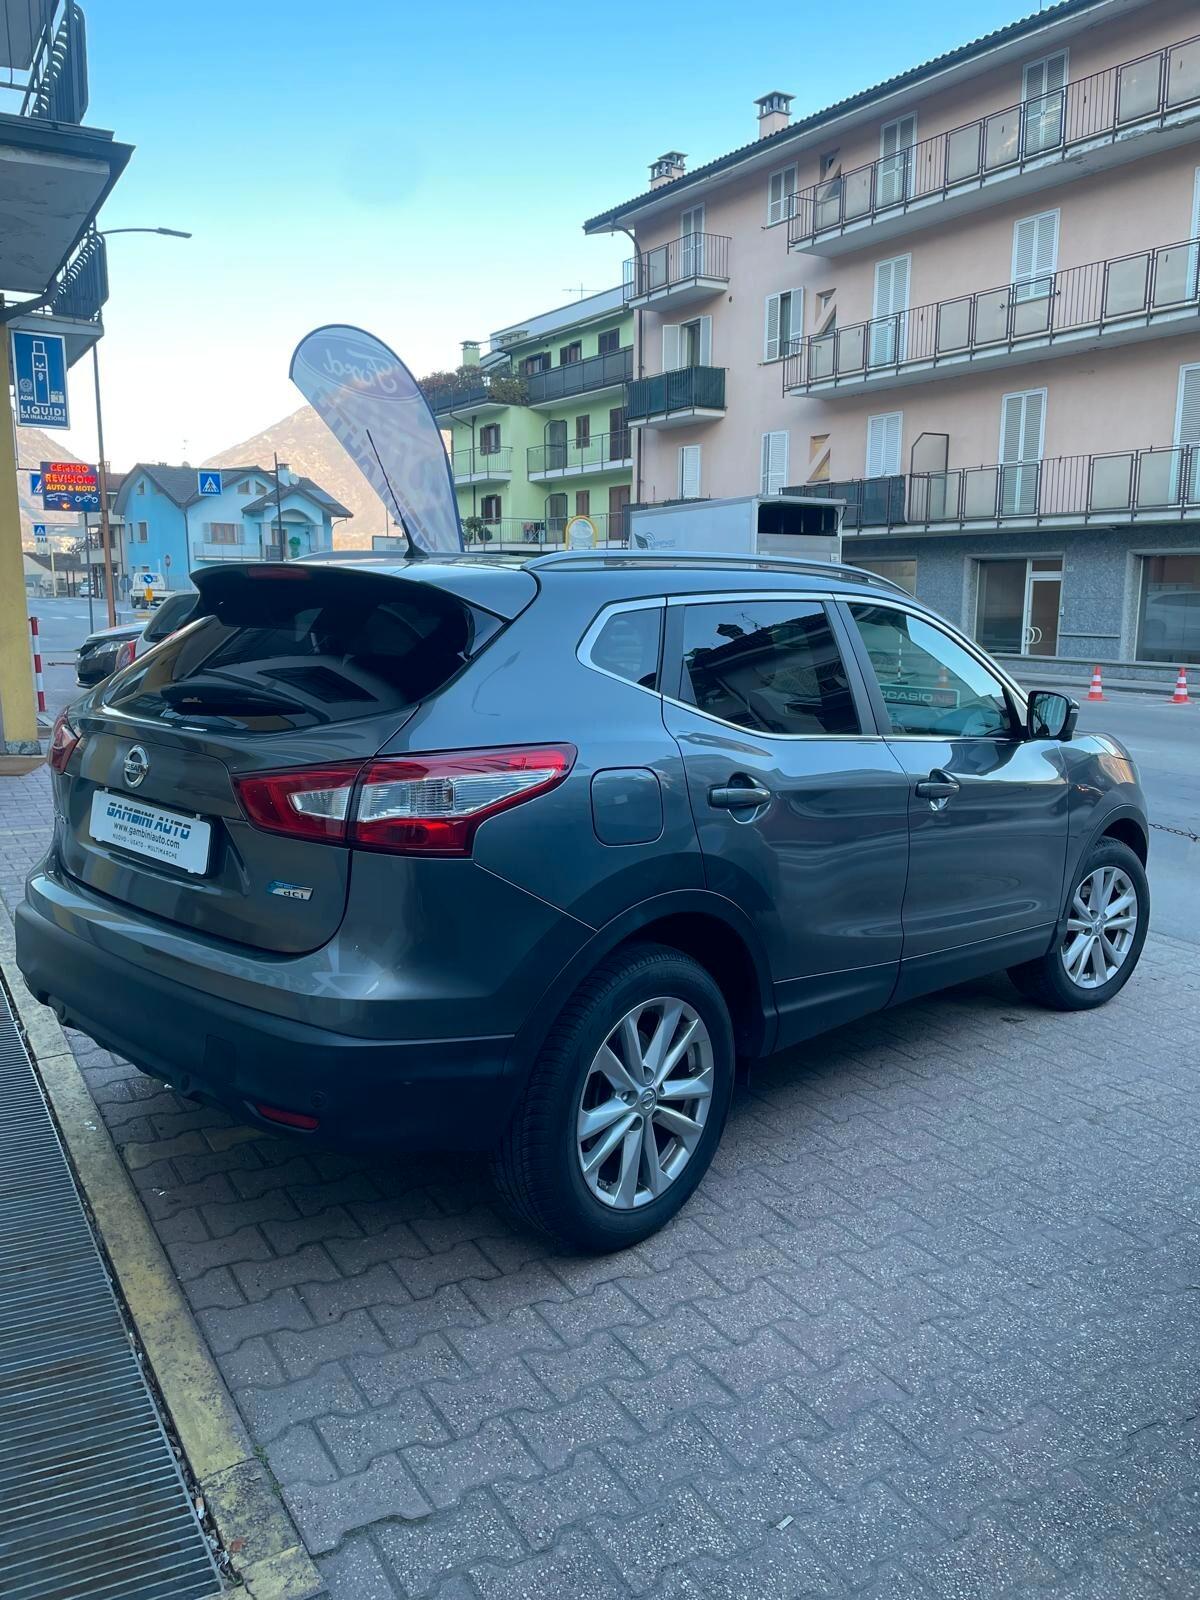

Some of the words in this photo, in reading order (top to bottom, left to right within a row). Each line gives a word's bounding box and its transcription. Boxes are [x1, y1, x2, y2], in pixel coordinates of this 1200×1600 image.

[20, 405, 66, 417] LIQUIDI
[30, 414, 66, 422] INALAZIONE
[50, 463, 89, 473] CENTRO
[880, 690, 955, 705] CCASIONE
[106, 802, 155, 828] GAMBINI
[154, 816, 192, 840] AUTO
[113, 822, 180, 849] www.gambiniauto.com
[147, 845, 177, 860] MULTIMARCHE
